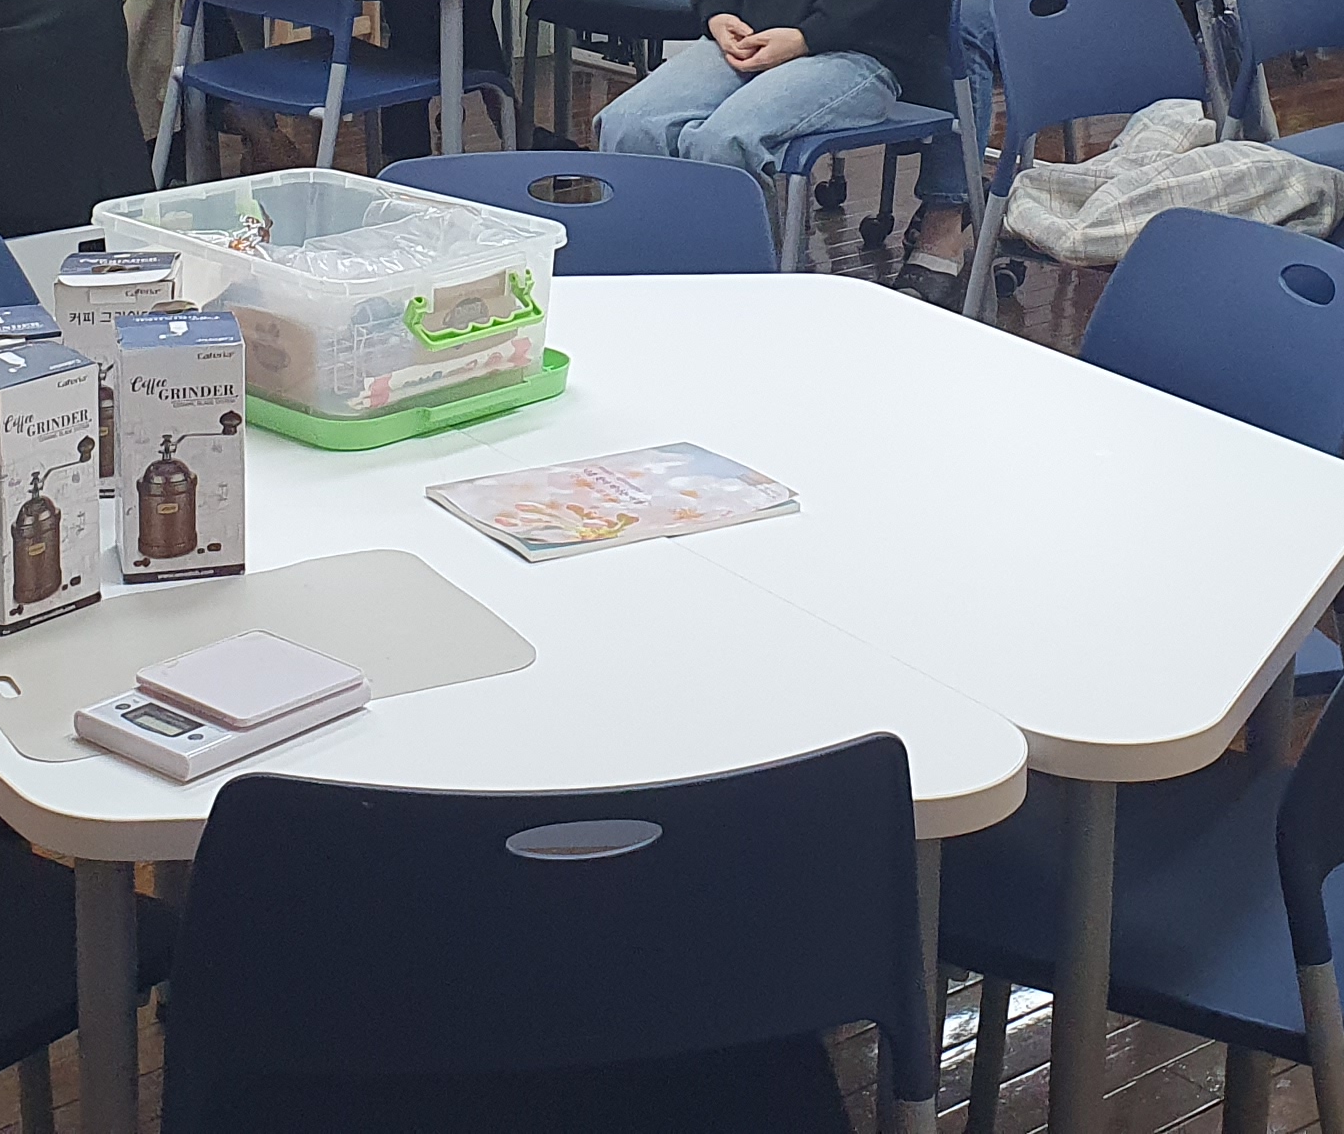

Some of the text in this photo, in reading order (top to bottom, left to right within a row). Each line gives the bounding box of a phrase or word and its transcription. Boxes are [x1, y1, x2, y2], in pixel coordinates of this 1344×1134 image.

[69, 312, 95, 325] 커피
[130, 375, 168, 396] Coffee
[158, 384, 234, 401] GRINDER
[26, 408, 90, 438] GRINDER
